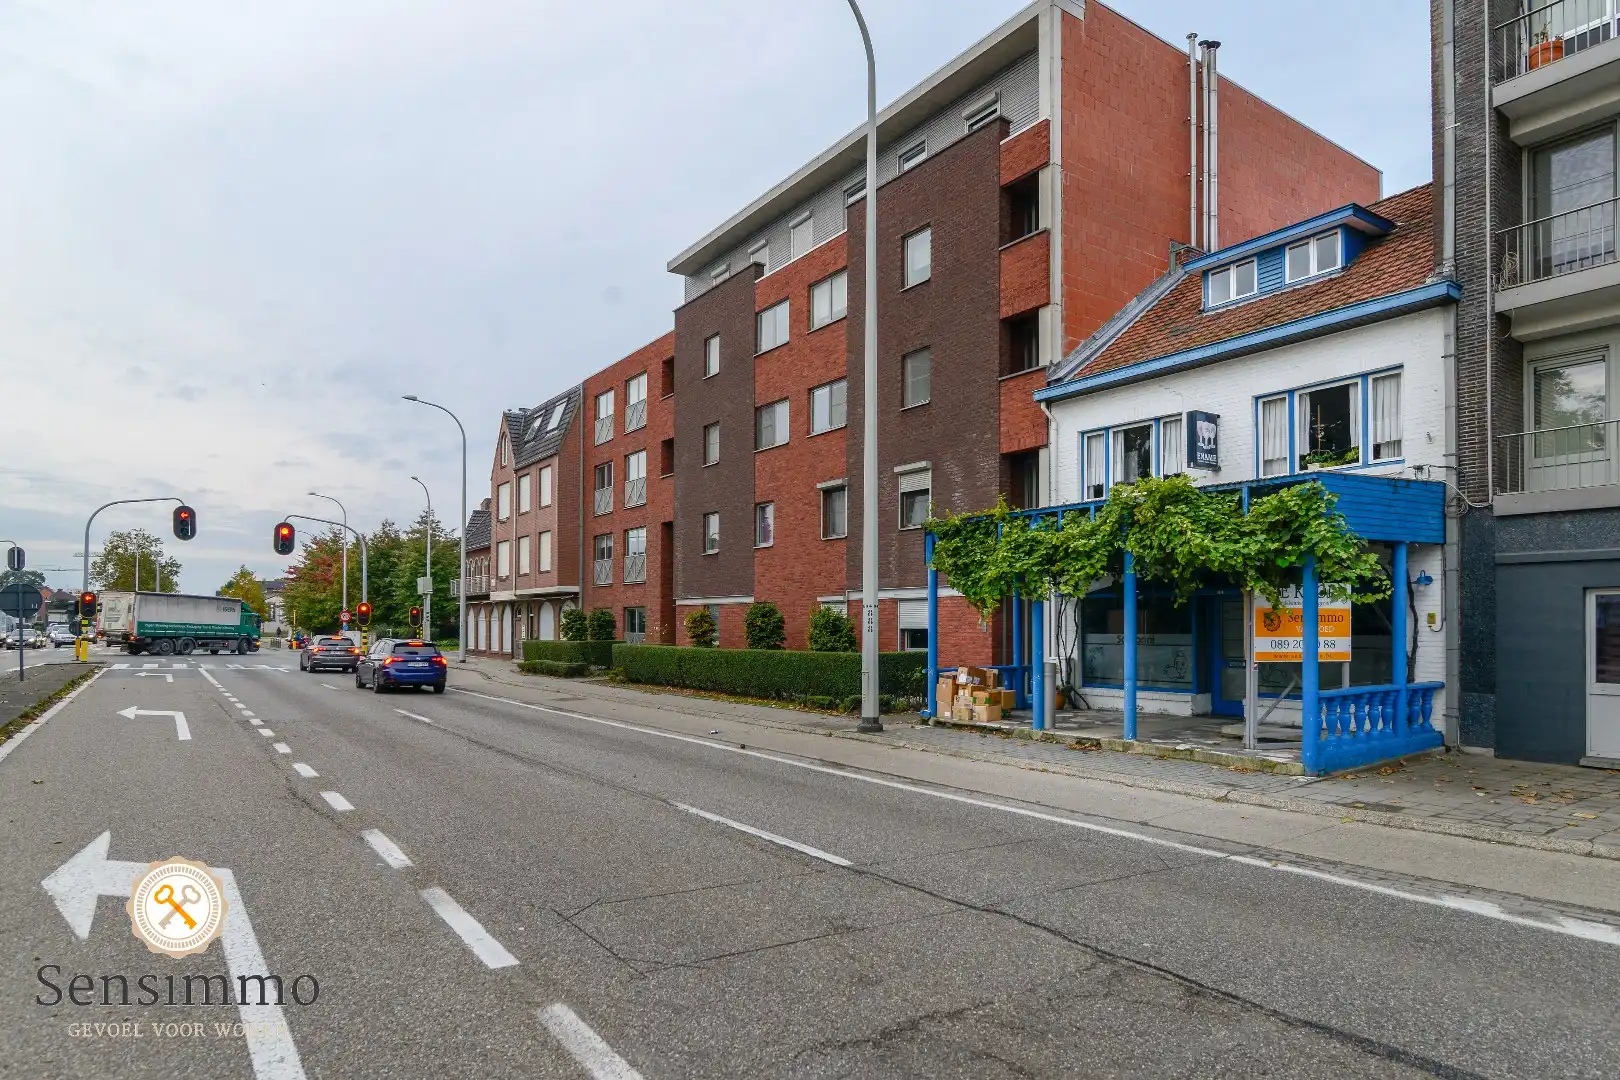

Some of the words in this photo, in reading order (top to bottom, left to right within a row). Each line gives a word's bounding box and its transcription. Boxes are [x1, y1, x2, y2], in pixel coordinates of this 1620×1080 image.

[1288, 614, 1344, 623] Semmo
[1270, 639, 1290, 650] 089
[1323, 639, 1336, 649] 88
